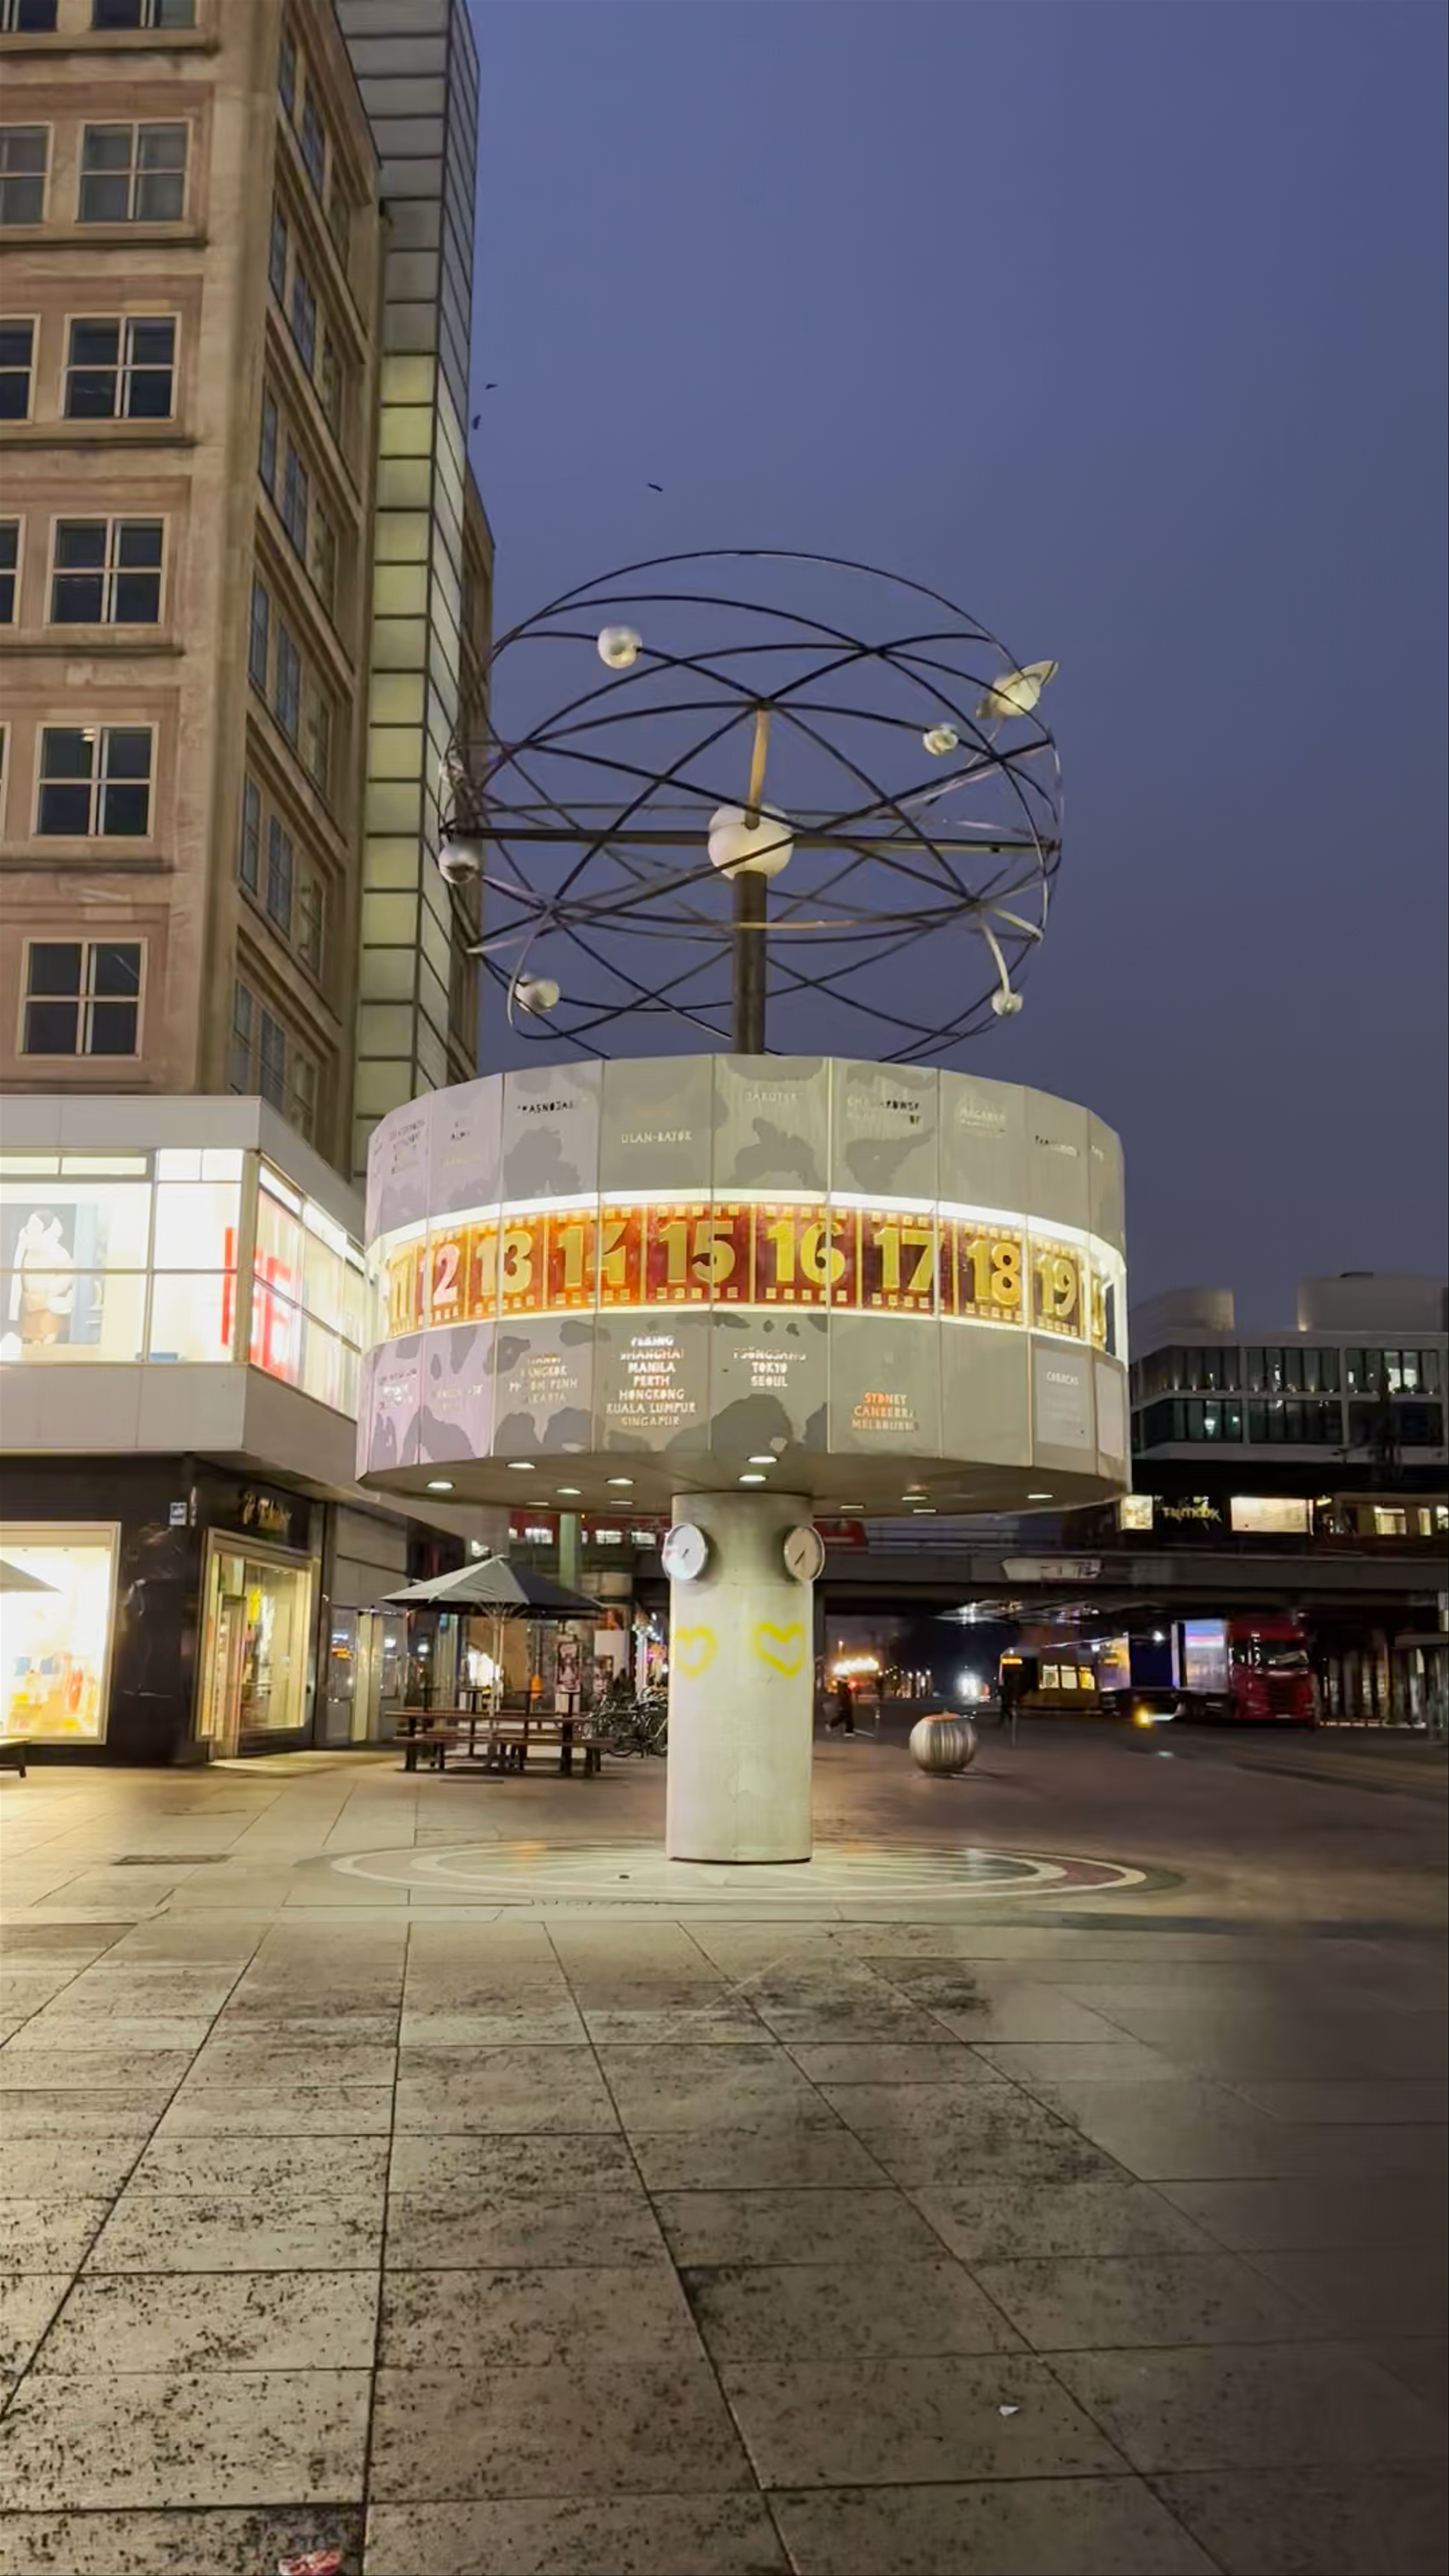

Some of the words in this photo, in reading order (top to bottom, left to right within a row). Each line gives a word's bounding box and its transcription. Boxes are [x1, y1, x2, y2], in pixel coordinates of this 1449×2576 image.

[558, 1221, 627, 1288] 14
[659, 1220, 736, 1284] 15
[766, 1220, 847, 1284] 16
[475, 1230, 533, 1296] 13
[874, 1226, 944, 1292] 17
[966, 1240, 1021, 1306] 18
[1034, 1255, 1076, 1318] 19
[627, 1361, 676, 1374] MANILA
[751, 1362, 788, 1374] TOKYO
[633, 1375, 670, 1387] PERTH
[750, 1375, 789, 1387] SEOUL
[618, 1389, 685, 1401] HONGKONG
[863, 1392, 908, 1405] SYDNEY
[606, 1403, 646, 1414] KUALA
[650, 1402, 696, 1413] LUMPUR
[621, 1415, 680, 1427] SINGAPUR
